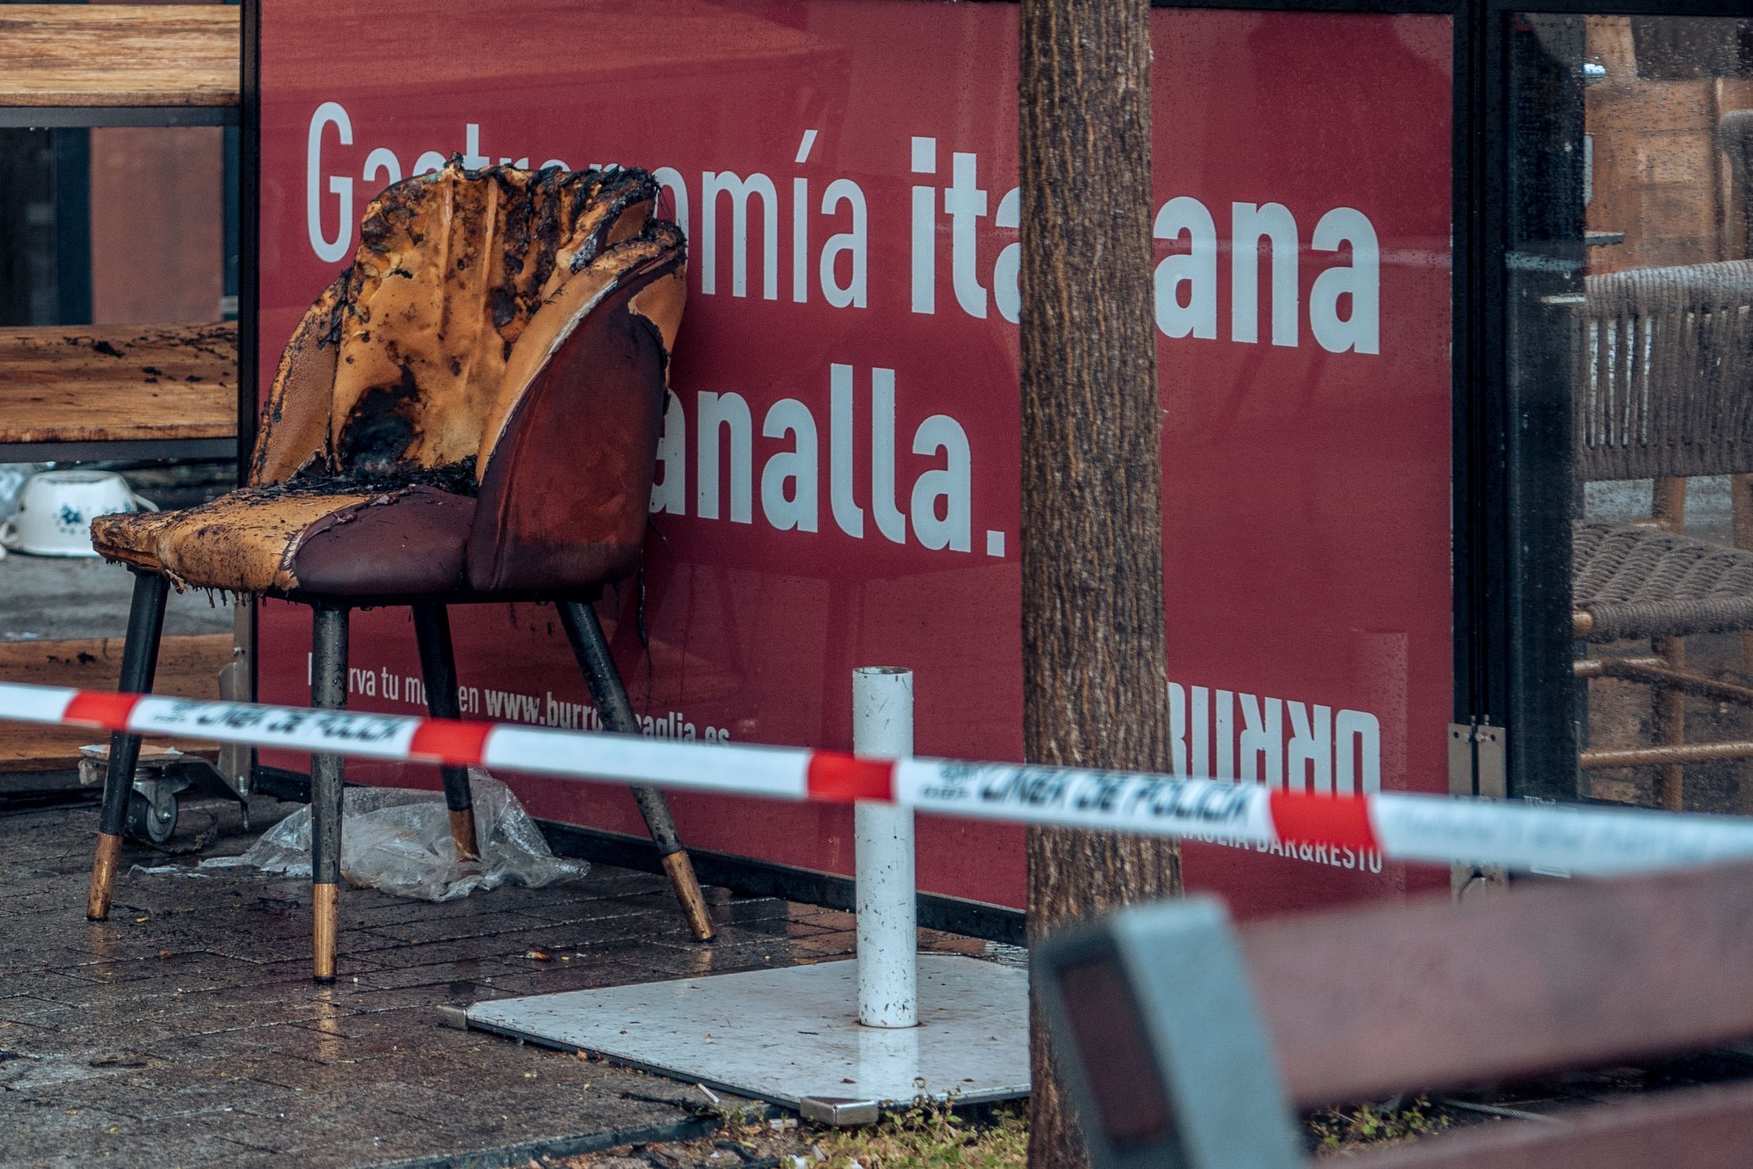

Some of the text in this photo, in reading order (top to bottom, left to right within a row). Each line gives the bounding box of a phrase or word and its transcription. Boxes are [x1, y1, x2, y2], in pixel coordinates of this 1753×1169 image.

[911, 136, 1380, 356] itana
[651, 362, 1006, 557] analla.
[381, 666, 399, 700] tu
[458, 685, 479, 714] en
